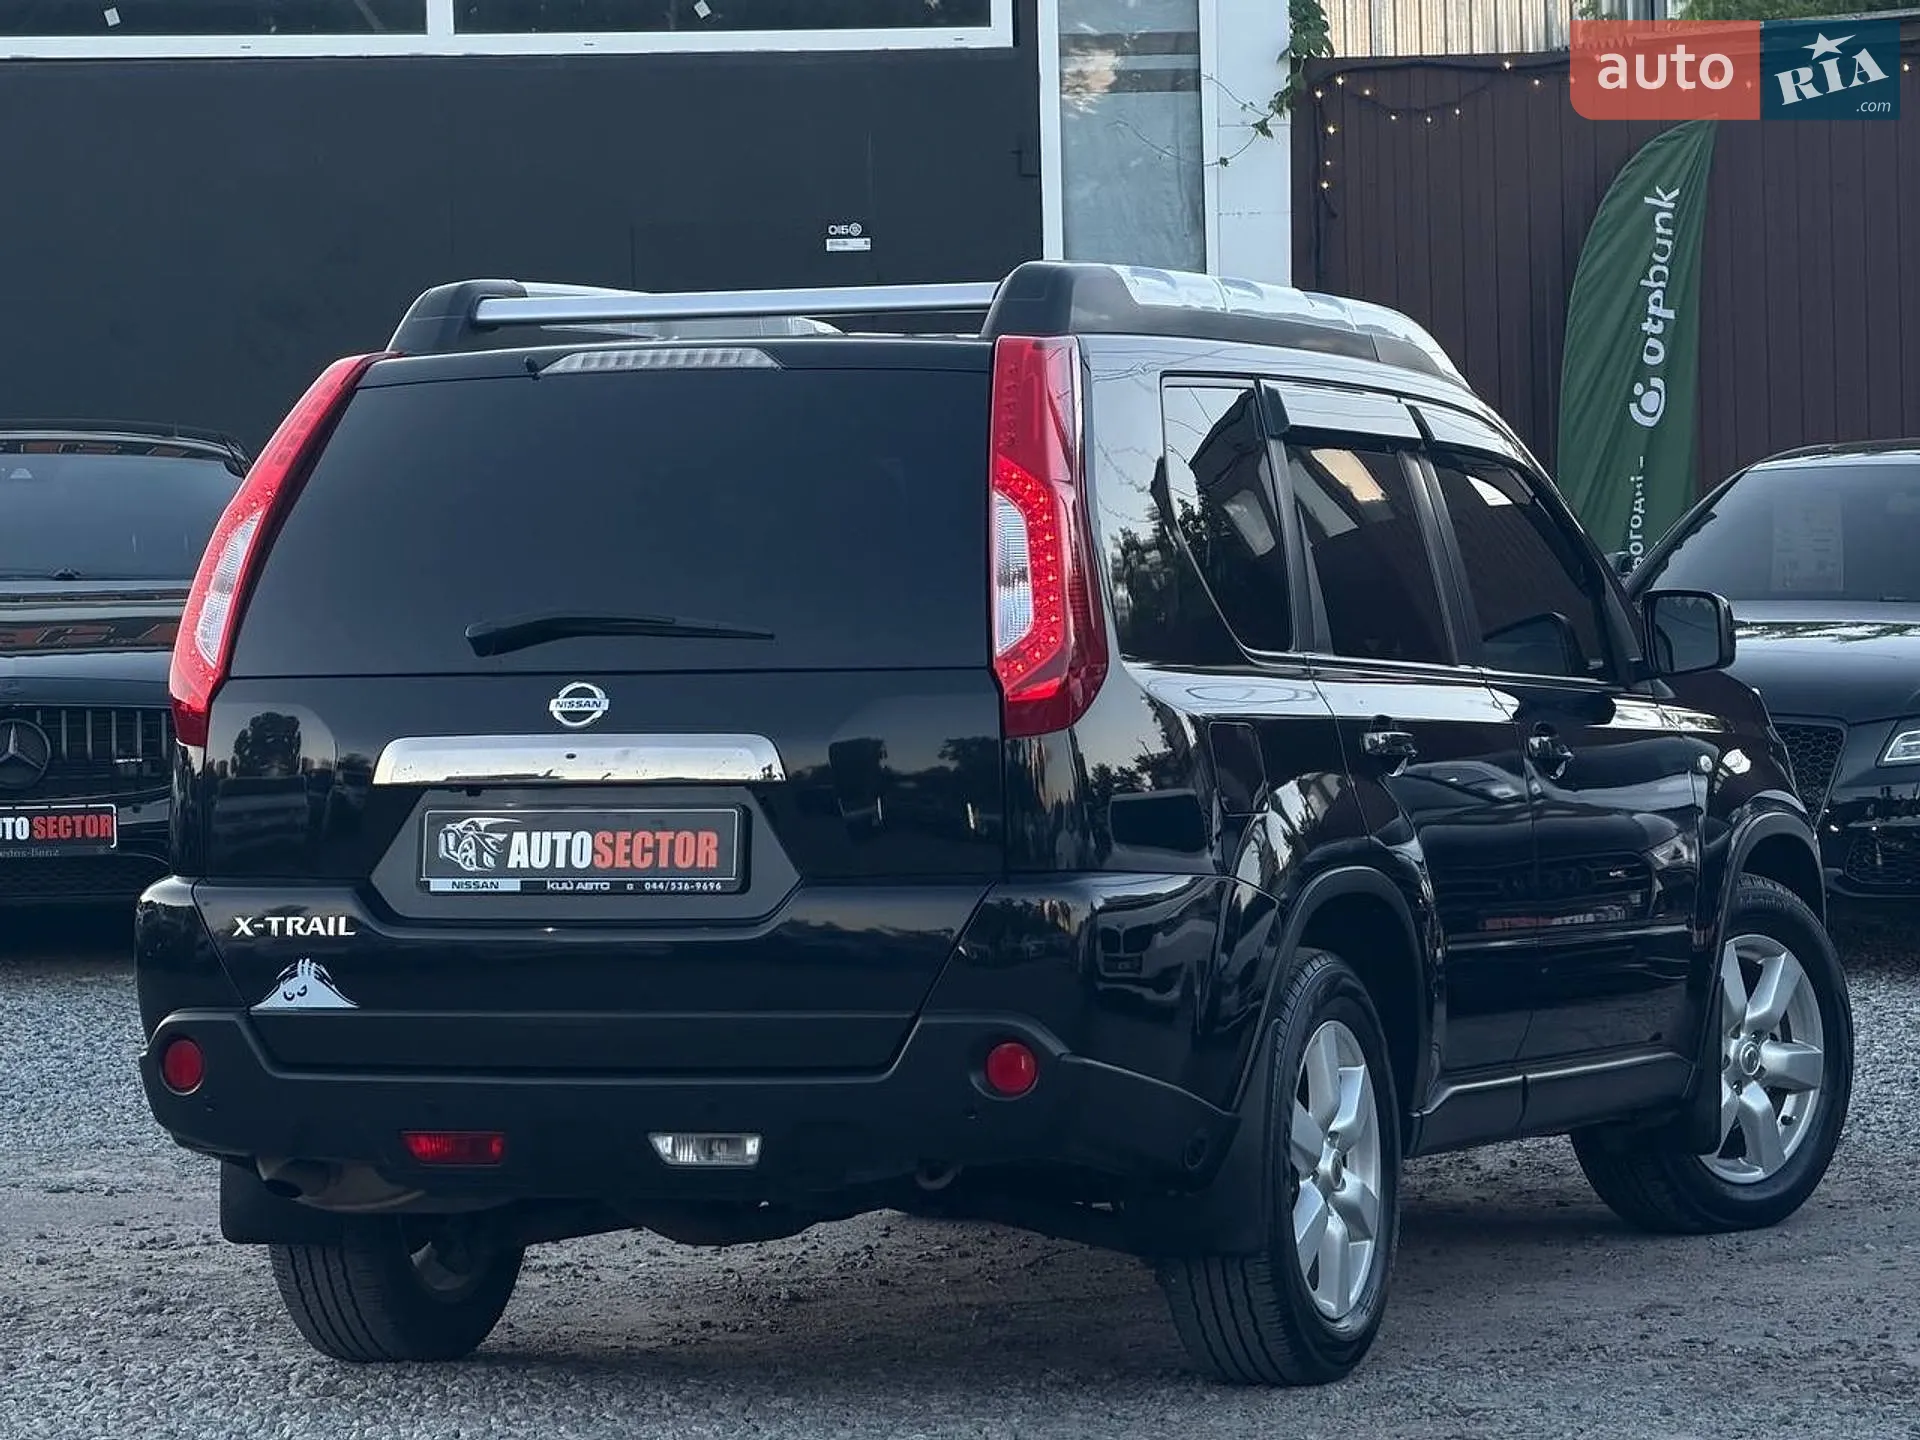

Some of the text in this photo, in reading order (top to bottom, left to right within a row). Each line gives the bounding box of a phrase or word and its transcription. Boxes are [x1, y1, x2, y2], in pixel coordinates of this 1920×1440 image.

[1639, 184, 1681, 366] otpbank
[555, 700, 601, 708] NISSAN
[0, 814, 112, 840] TO SECTOR
[451, 880, 500, 889] NISSAN
[232, 916, 357, 937] X-TRAIL
